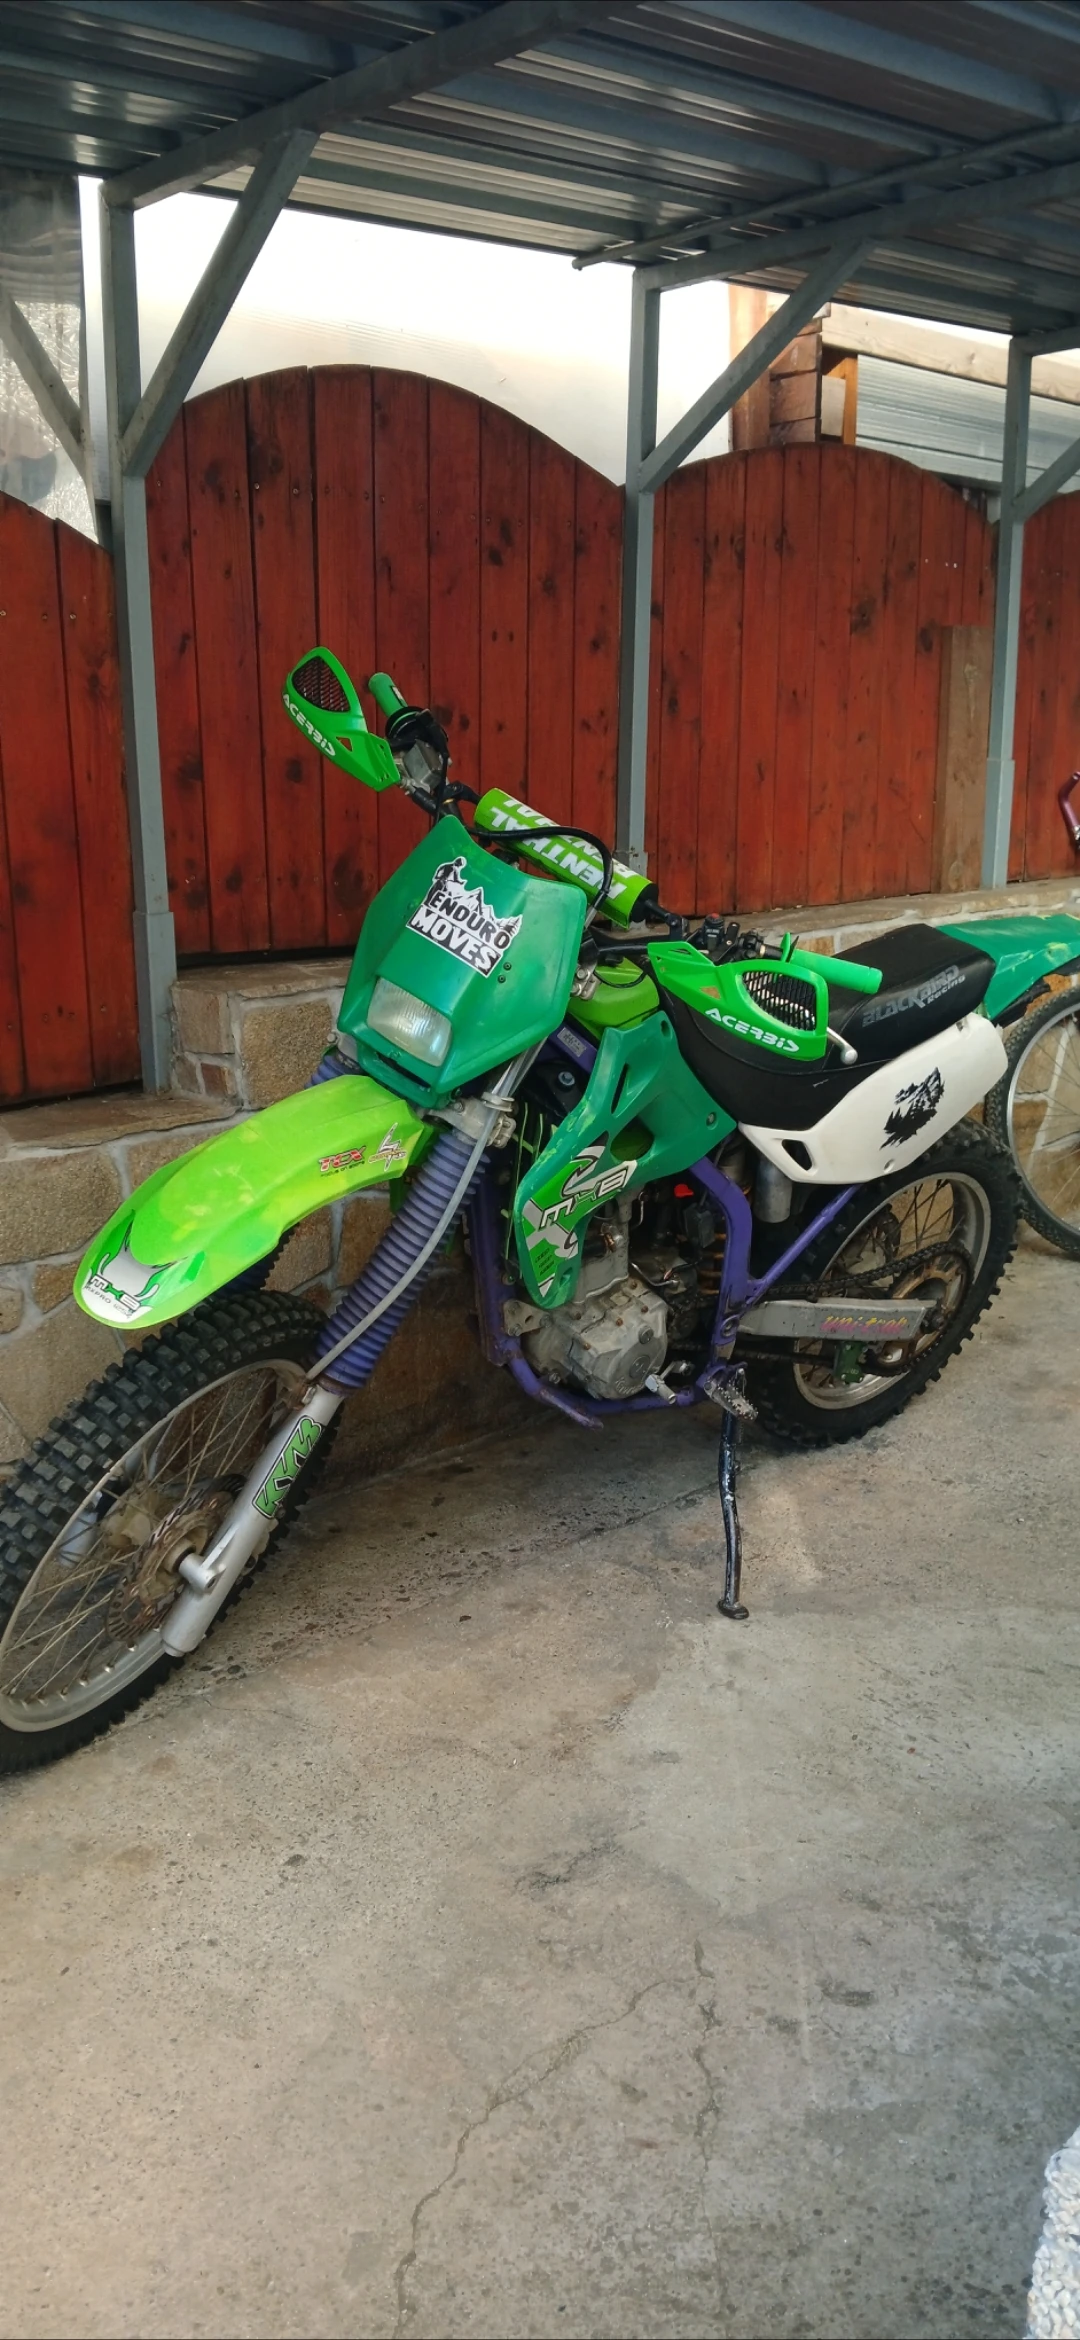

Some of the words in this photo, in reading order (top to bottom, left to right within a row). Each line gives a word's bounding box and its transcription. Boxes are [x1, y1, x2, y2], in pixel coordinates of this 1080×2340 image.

[283, 694, 336, 757] ACERBIS
[410, 908, 498, 971] MOVES
[429, 891, 511, 950] ENDURO
[704, 1006, 800, 1053] ACERBIS
